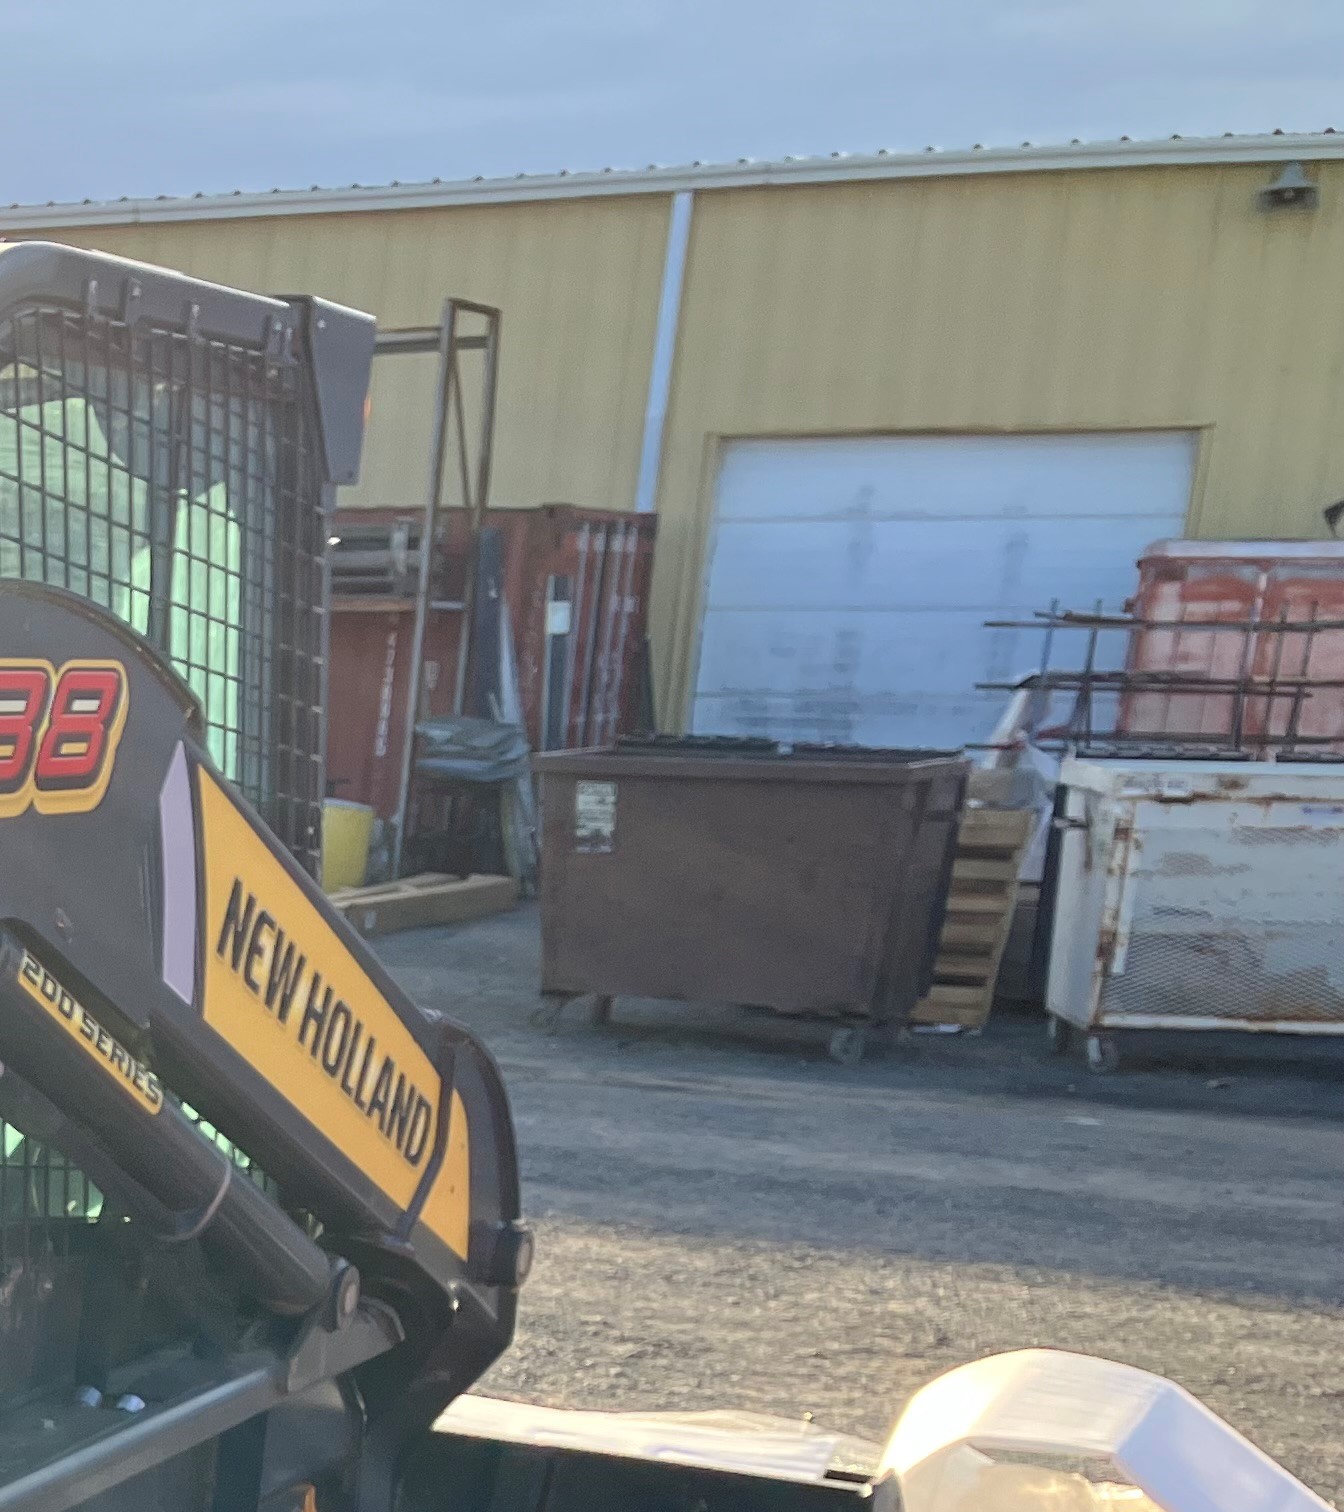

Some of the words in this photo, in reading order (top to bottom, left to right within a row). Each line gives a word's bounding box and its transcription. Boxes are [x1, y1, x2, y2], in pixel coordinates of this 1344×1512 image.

[21, 952, 77, 1021] 200
[79, 1009, 162, 1105] SERIES
[216, 876, 307, 1025] NEW
[297, 970, 433, 1167] HOLLAND
